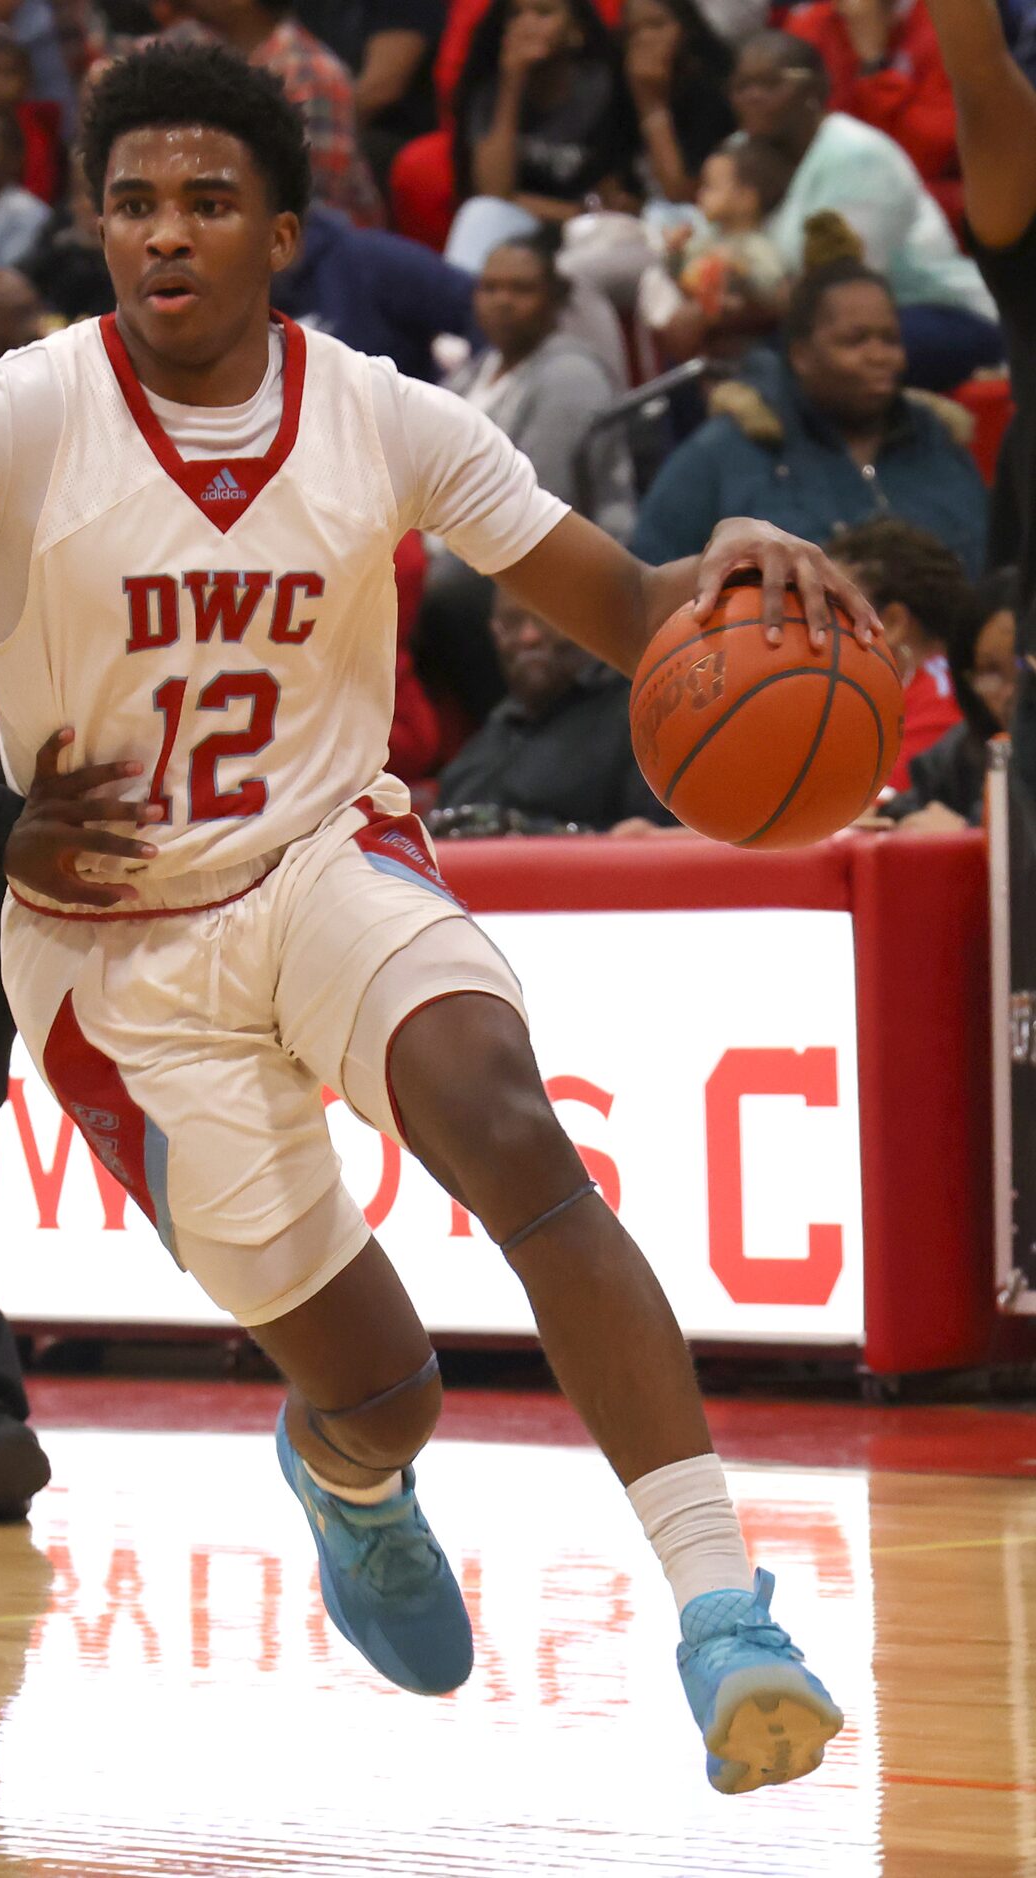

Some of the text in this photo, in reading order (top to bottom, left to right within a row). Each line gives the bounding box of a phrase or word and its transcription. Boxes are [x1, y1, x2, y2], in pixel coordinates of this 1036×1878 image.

[200, 486, 248, 503] adidas
[122, 570, 325, 655] DWC
[136, 669, 283, 827] 12
[704, 1046, 843, 1306] C
